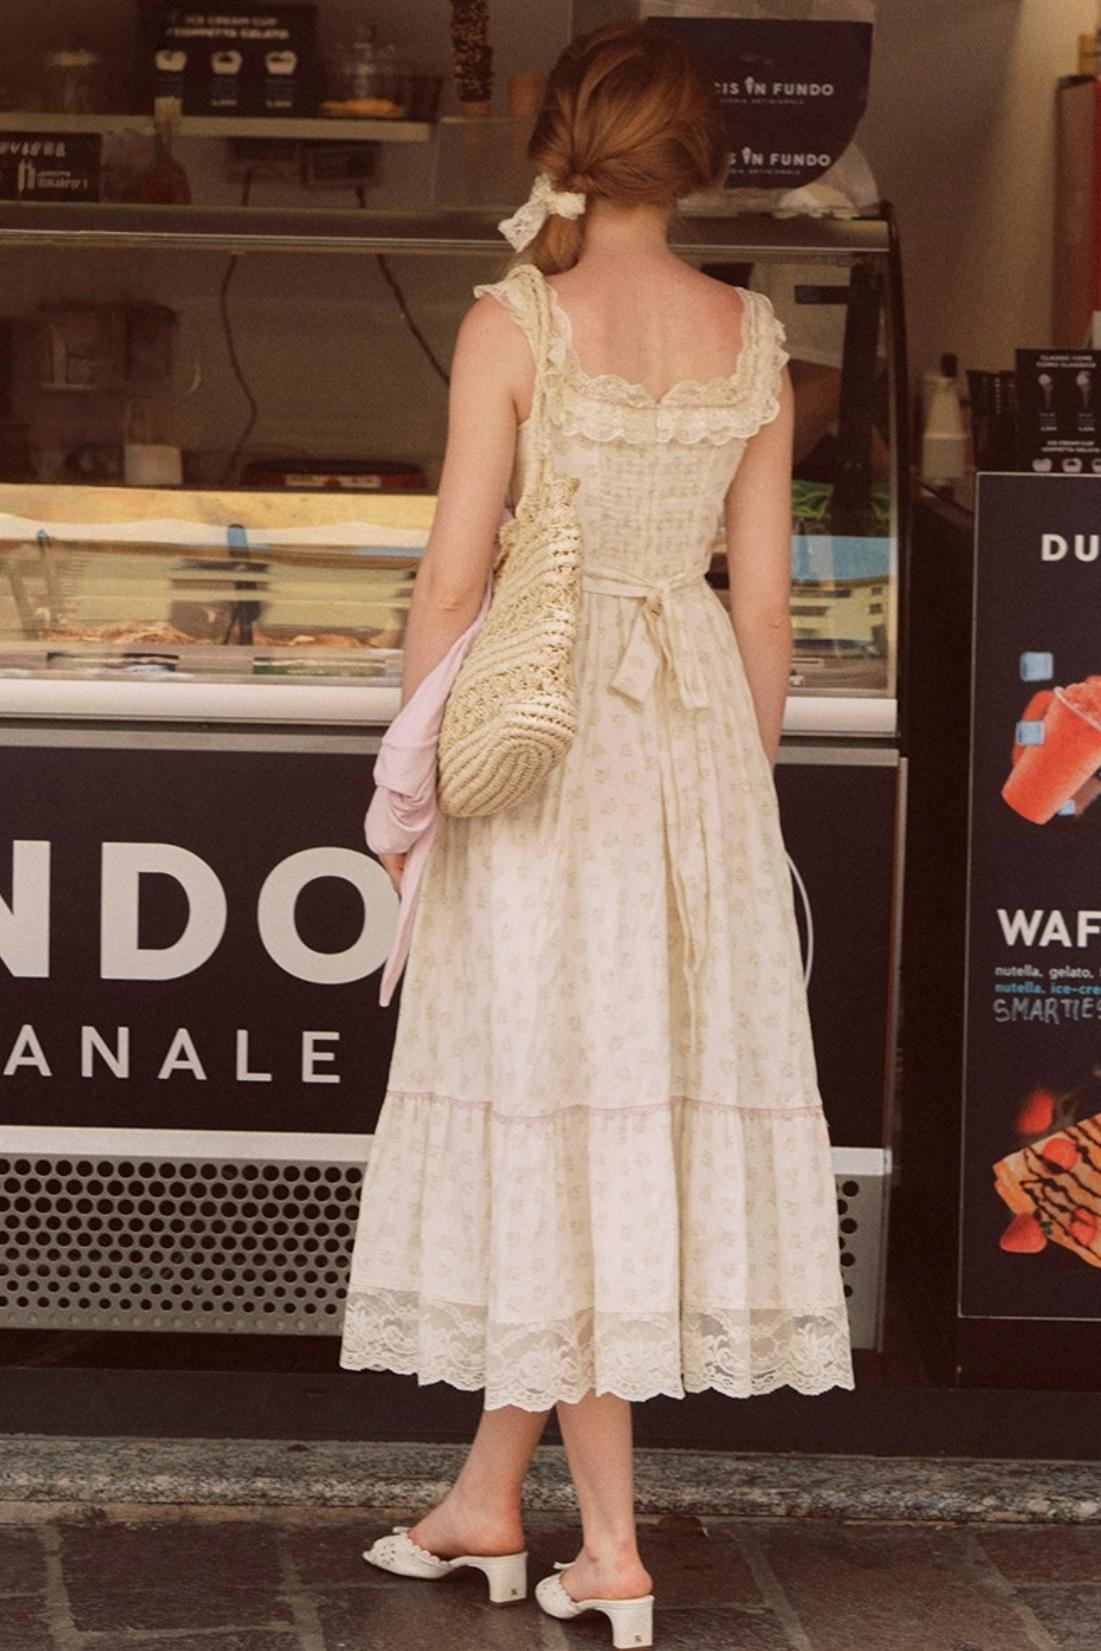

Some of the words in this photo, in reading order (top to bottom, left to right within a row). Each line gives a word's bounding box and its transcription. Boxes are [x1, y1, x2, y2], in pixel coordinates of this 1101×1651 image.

[773, 83, 834, 96] FUNDO
[769, 153, 831, 166] FUNDO
[1041, 533, 1101, 562] DU
[997, 908, 1101, 948] WAF
[3, 1024, 341, 1084] ANALE
